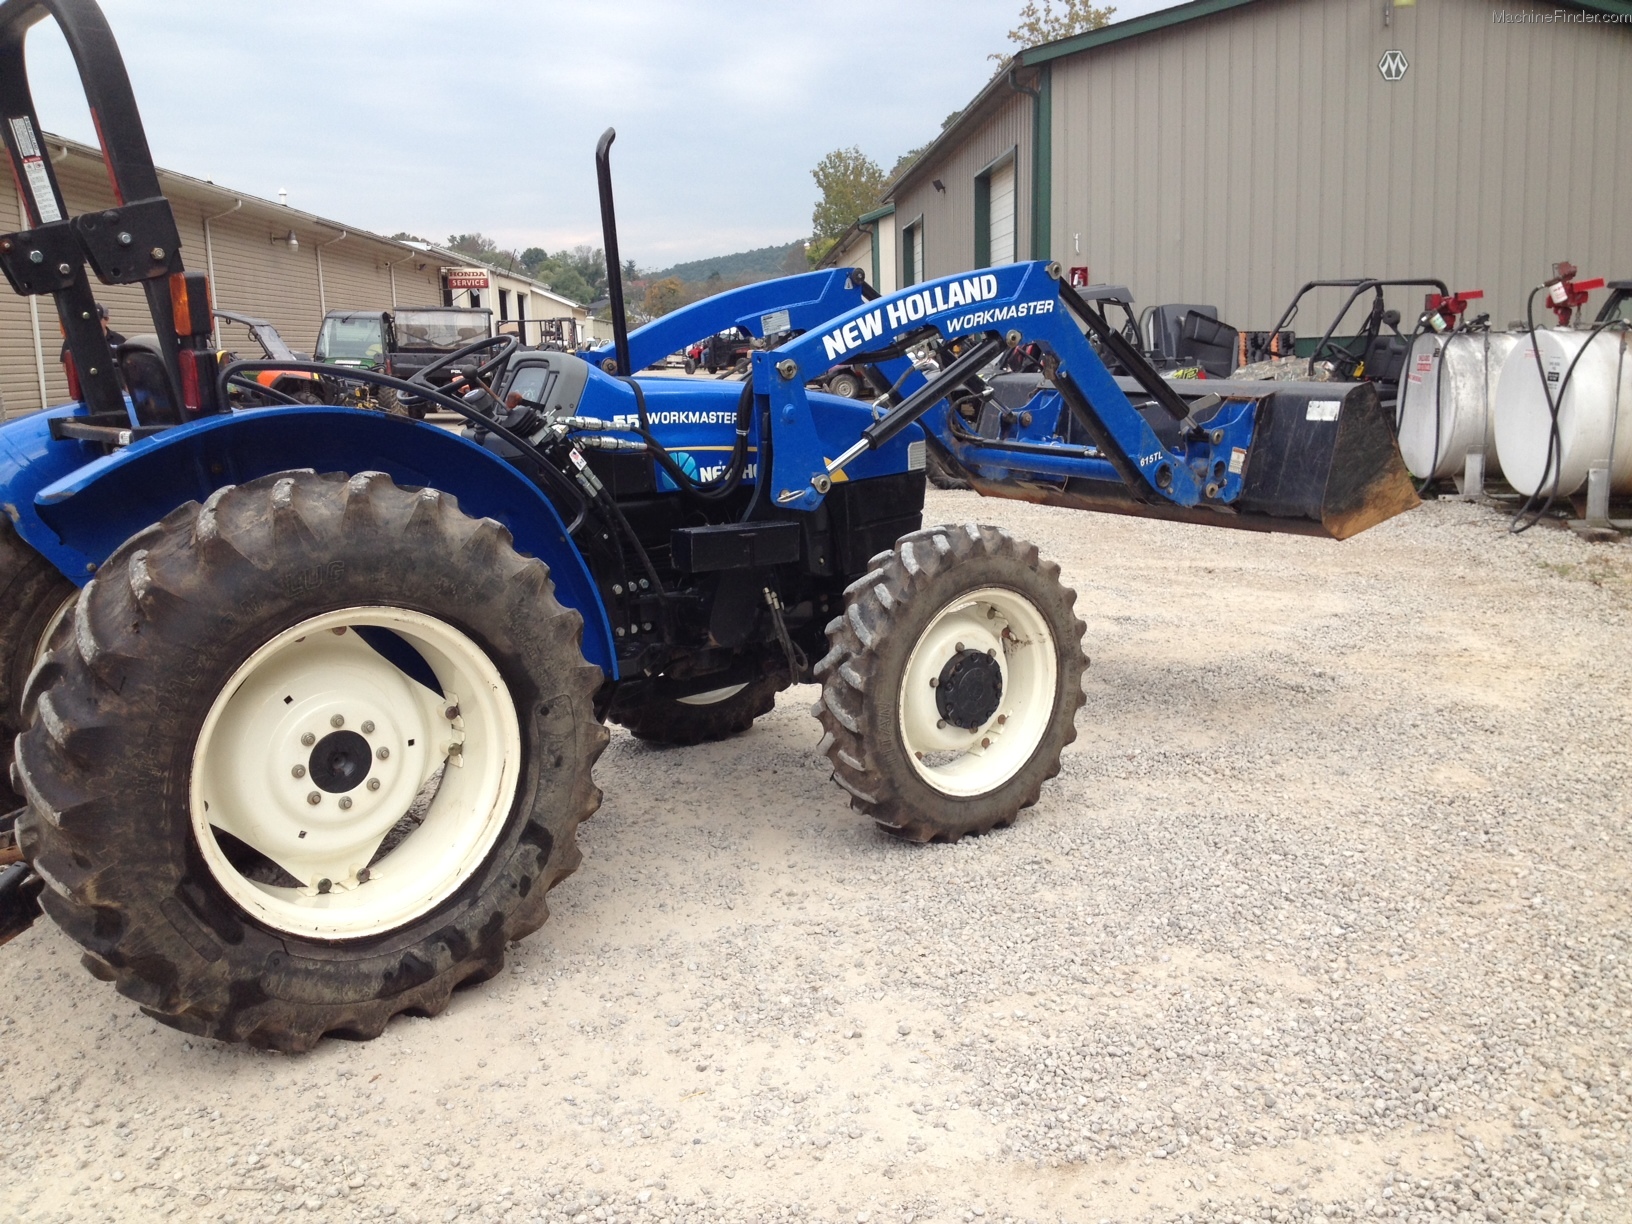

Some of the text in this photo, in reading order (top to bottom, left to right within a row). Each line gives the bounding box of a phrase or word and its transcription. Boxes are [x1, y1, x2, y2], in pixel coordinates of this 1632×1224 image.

[821, 309, 883, 361] NEW
[887, 274, 998, 329] HOLLAND
[946, 300, 1054, 333] WORKMASTER
[1140, 451, 1163, 467] 615TL
[284, 560, 345, 598] LUG
